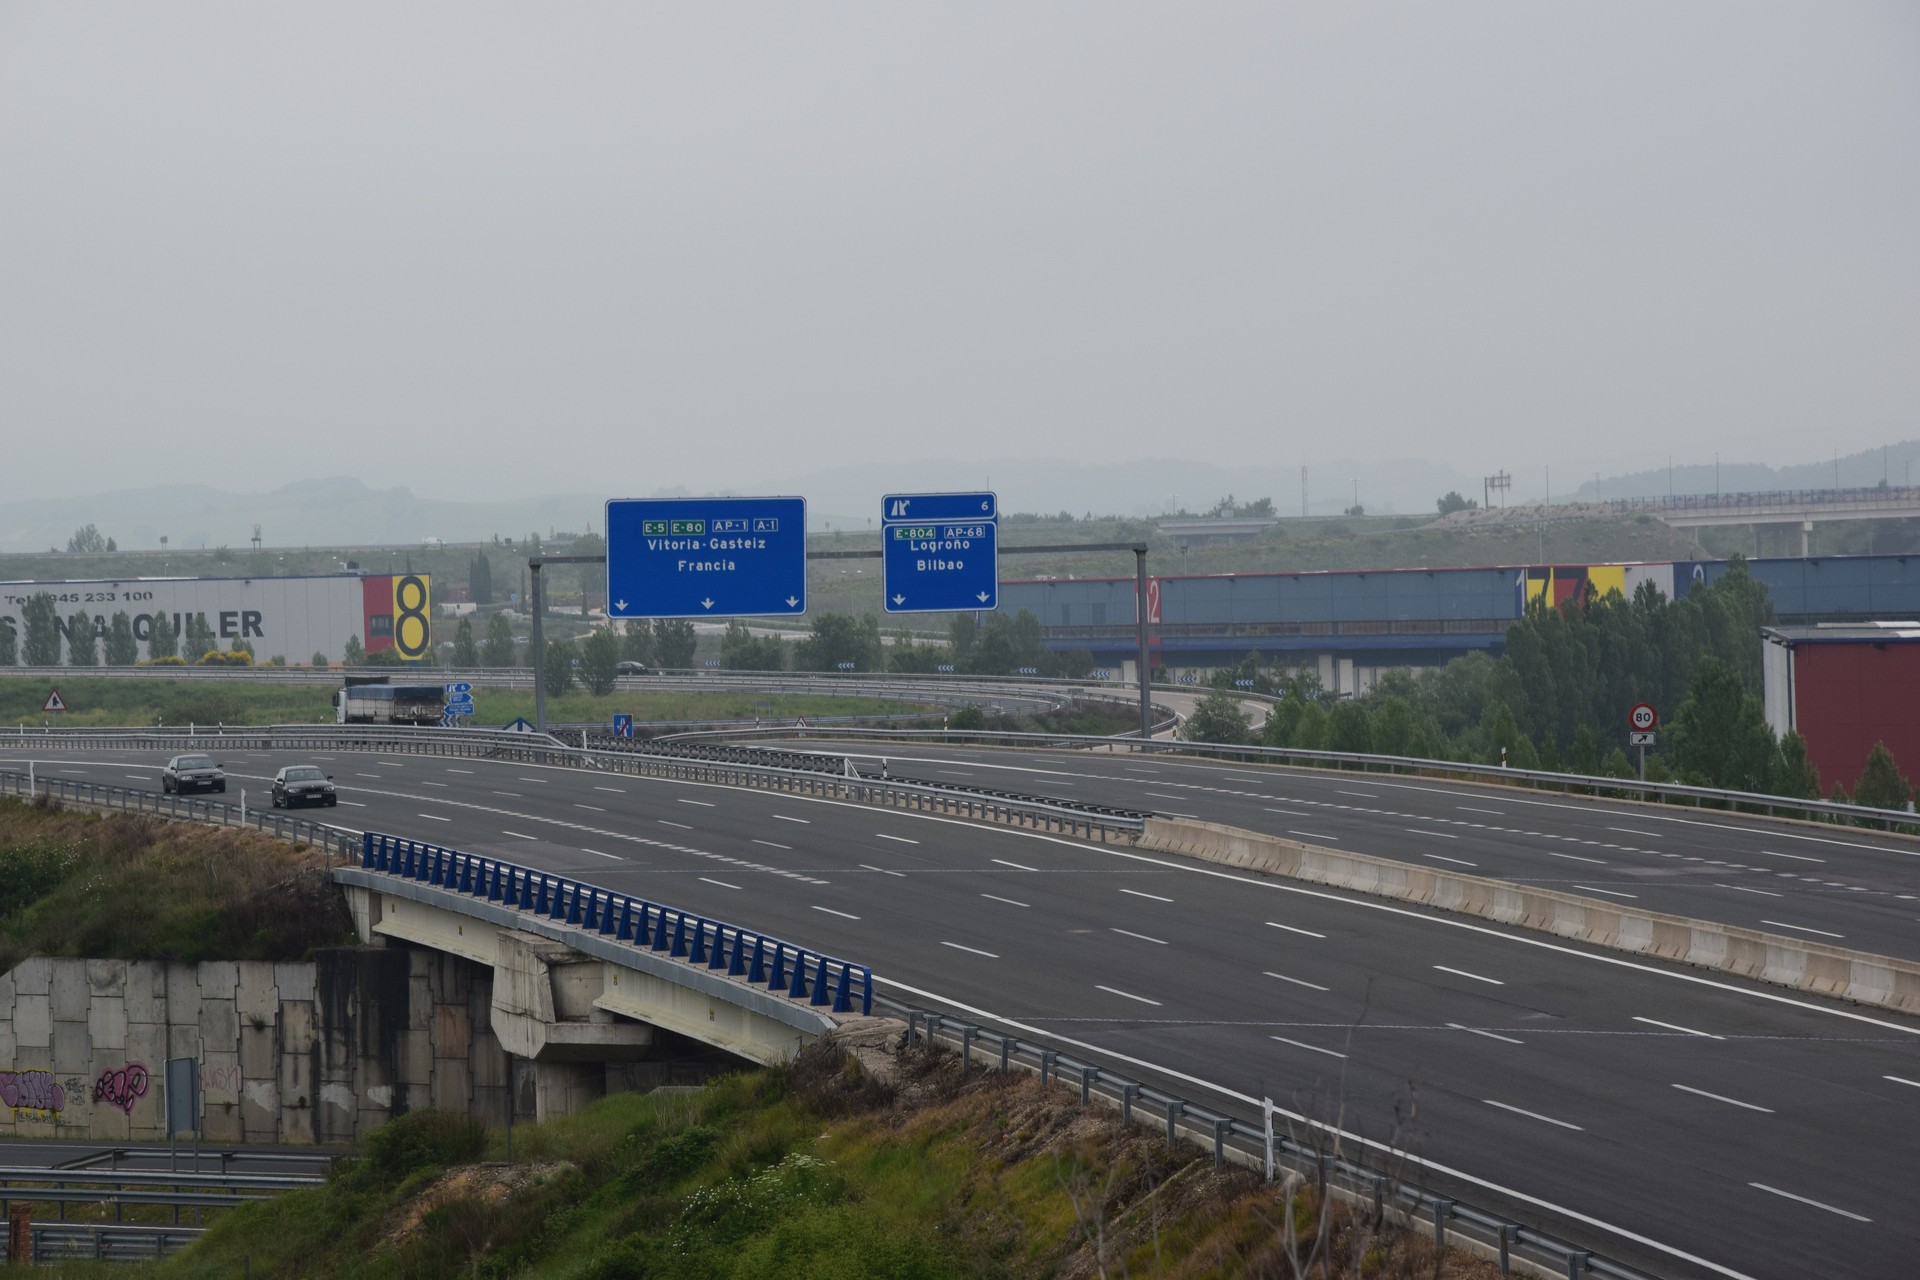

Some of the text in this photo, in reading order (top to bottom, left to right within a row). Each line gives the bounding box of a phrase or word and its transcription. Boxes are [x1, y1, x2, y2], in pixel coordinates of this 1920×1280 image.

[981, 501, 989, 511] 6
[645, 520, 775, 533] E-5 E-80 AP-1 A-1
[895, 527, 983, 539] E-804 AP-68
[910, 540, 970, 553] Logroño
[678, 560, 736, 572] Francia
[917, 560, 964, 571] Bilbao
[48, 593, 79, 604] 945
[84, 592, 116, 603] 233
[122, 591, 153, 602] 100
[396, 575, 430, 657] 8
[1635, 712, 1651, 722] 80
